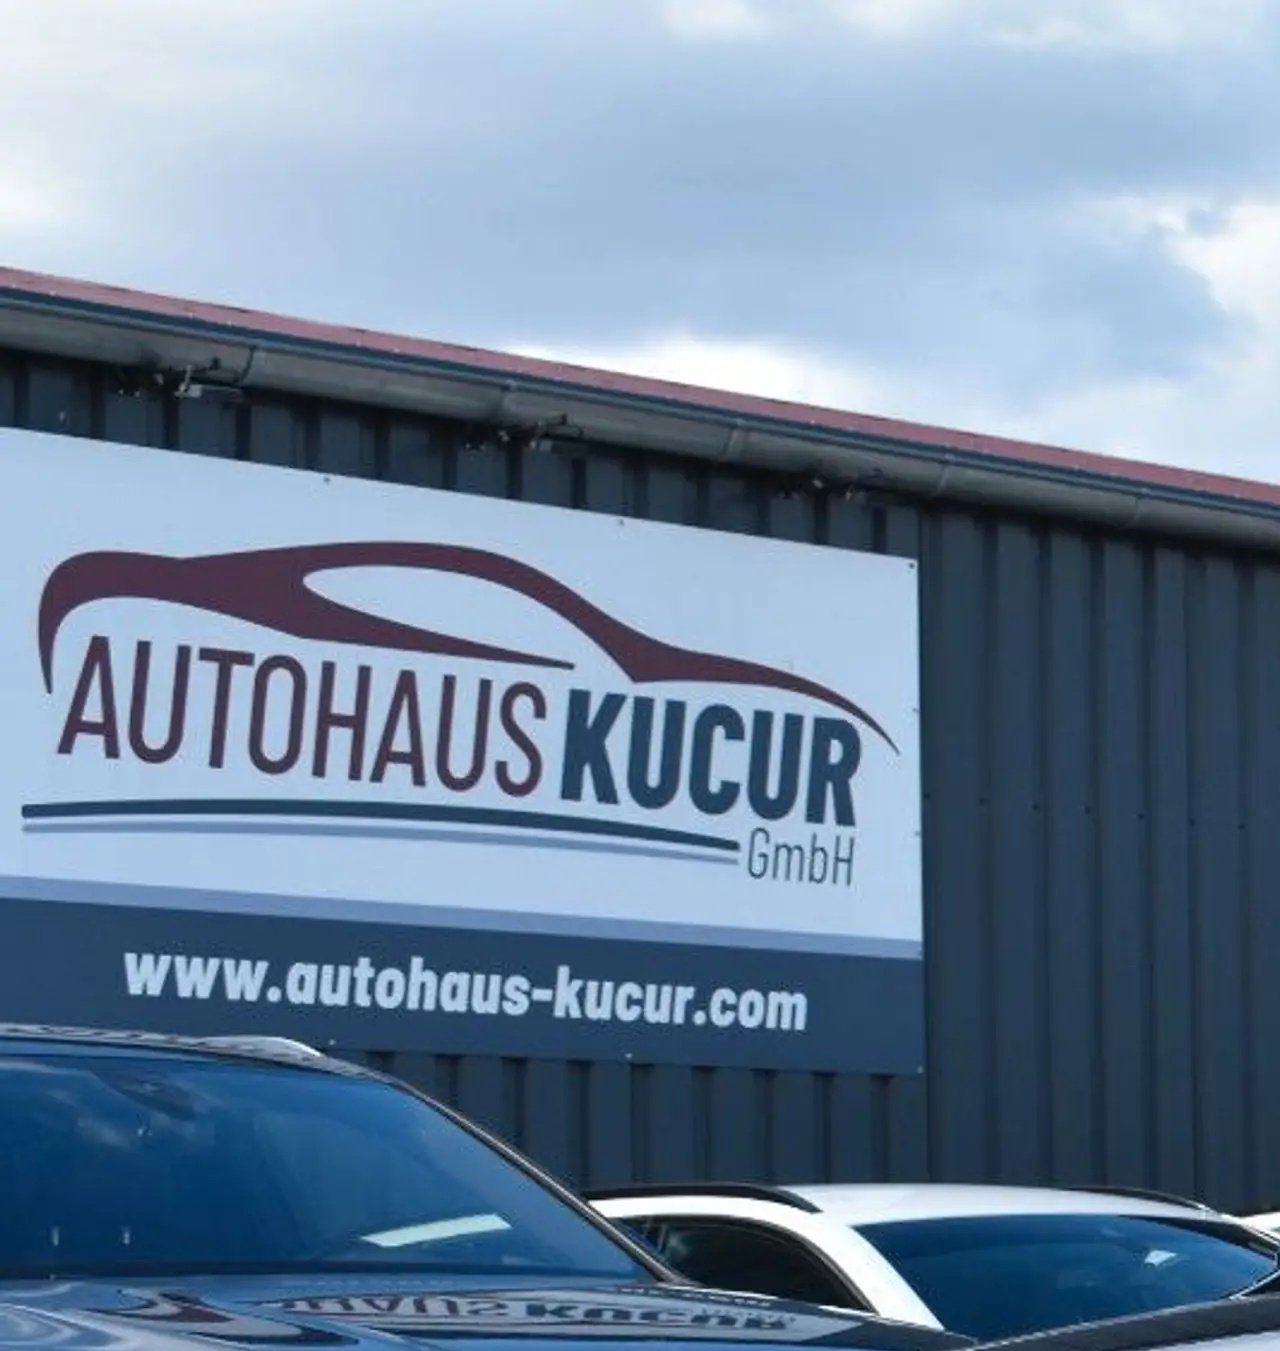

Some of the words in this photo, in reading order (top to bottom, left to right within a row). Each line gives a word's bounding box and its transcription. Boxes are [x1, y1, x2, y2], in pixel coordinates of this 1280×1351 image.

[57, 635, 546, 797] AUTOHAUS
[560, 688, 861, 826] KUCUR
[746, 828, 855, 887] GmbH
[123, 951, 808, 1031] www.autohaus-kucur.com
